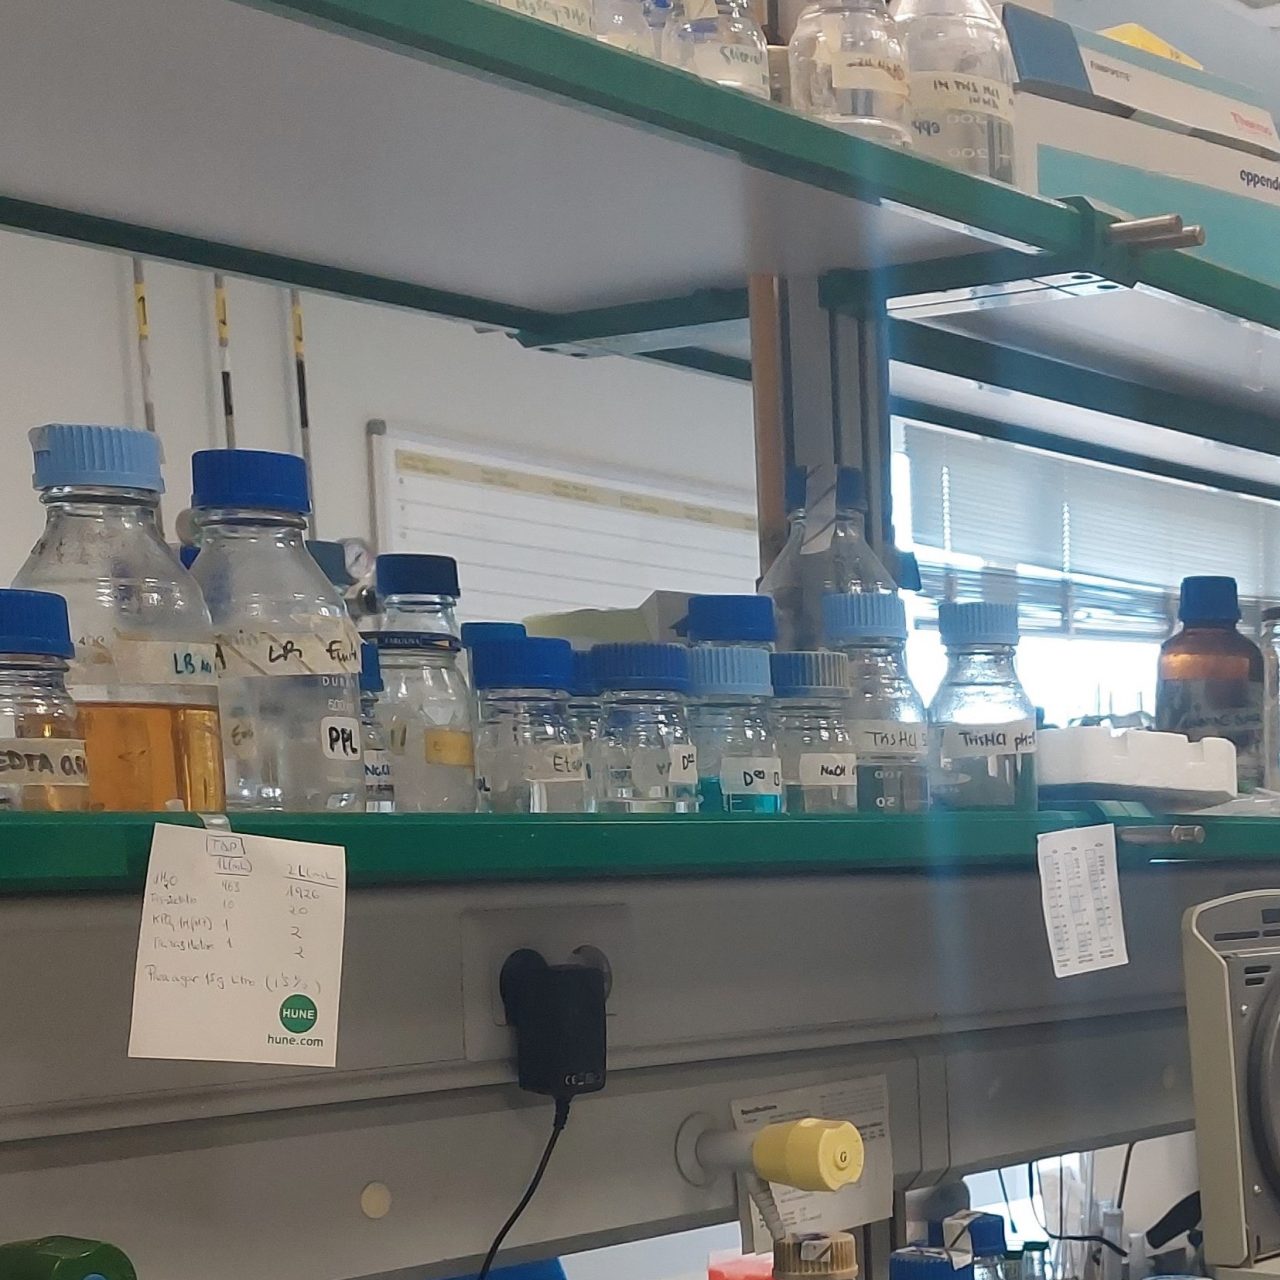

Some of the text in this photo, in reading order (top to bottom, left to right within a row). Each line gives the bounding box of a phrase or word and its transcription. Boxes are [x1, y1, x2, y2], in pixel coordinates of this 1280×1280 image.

[291, 926, 302, 939] 2
[282, 1008, 315, 1020] HUNE
[267, 1034, 323, 1048] hune.com
